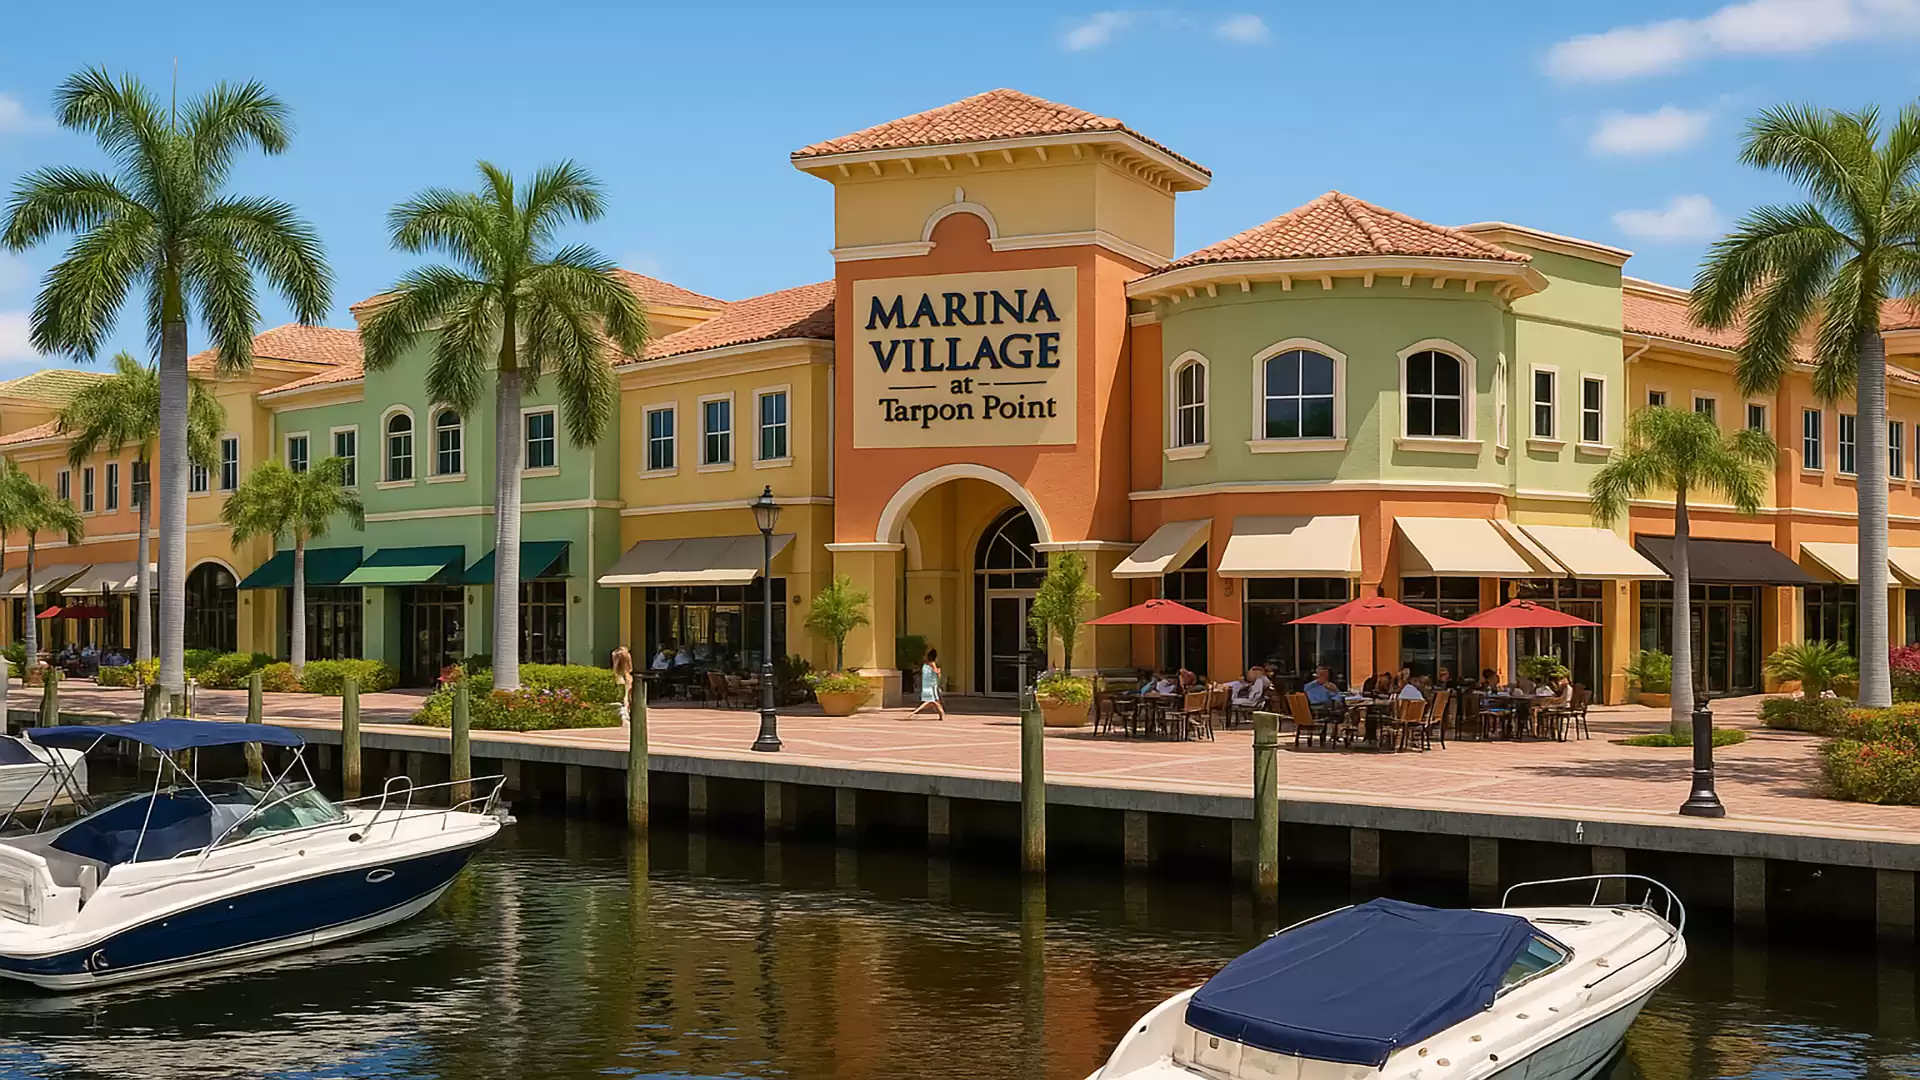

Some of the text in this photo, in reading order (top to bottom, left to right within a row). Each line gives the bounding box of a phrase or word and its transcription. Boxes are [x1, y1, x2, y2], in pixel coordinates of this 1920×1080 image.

[865, 288, 1061, 330] MARINA
[868, 332, 1061, 374] VILLAGE
[950, 376, 974, 394] at
[878, 394, 1057, 429] Tarpon Point
